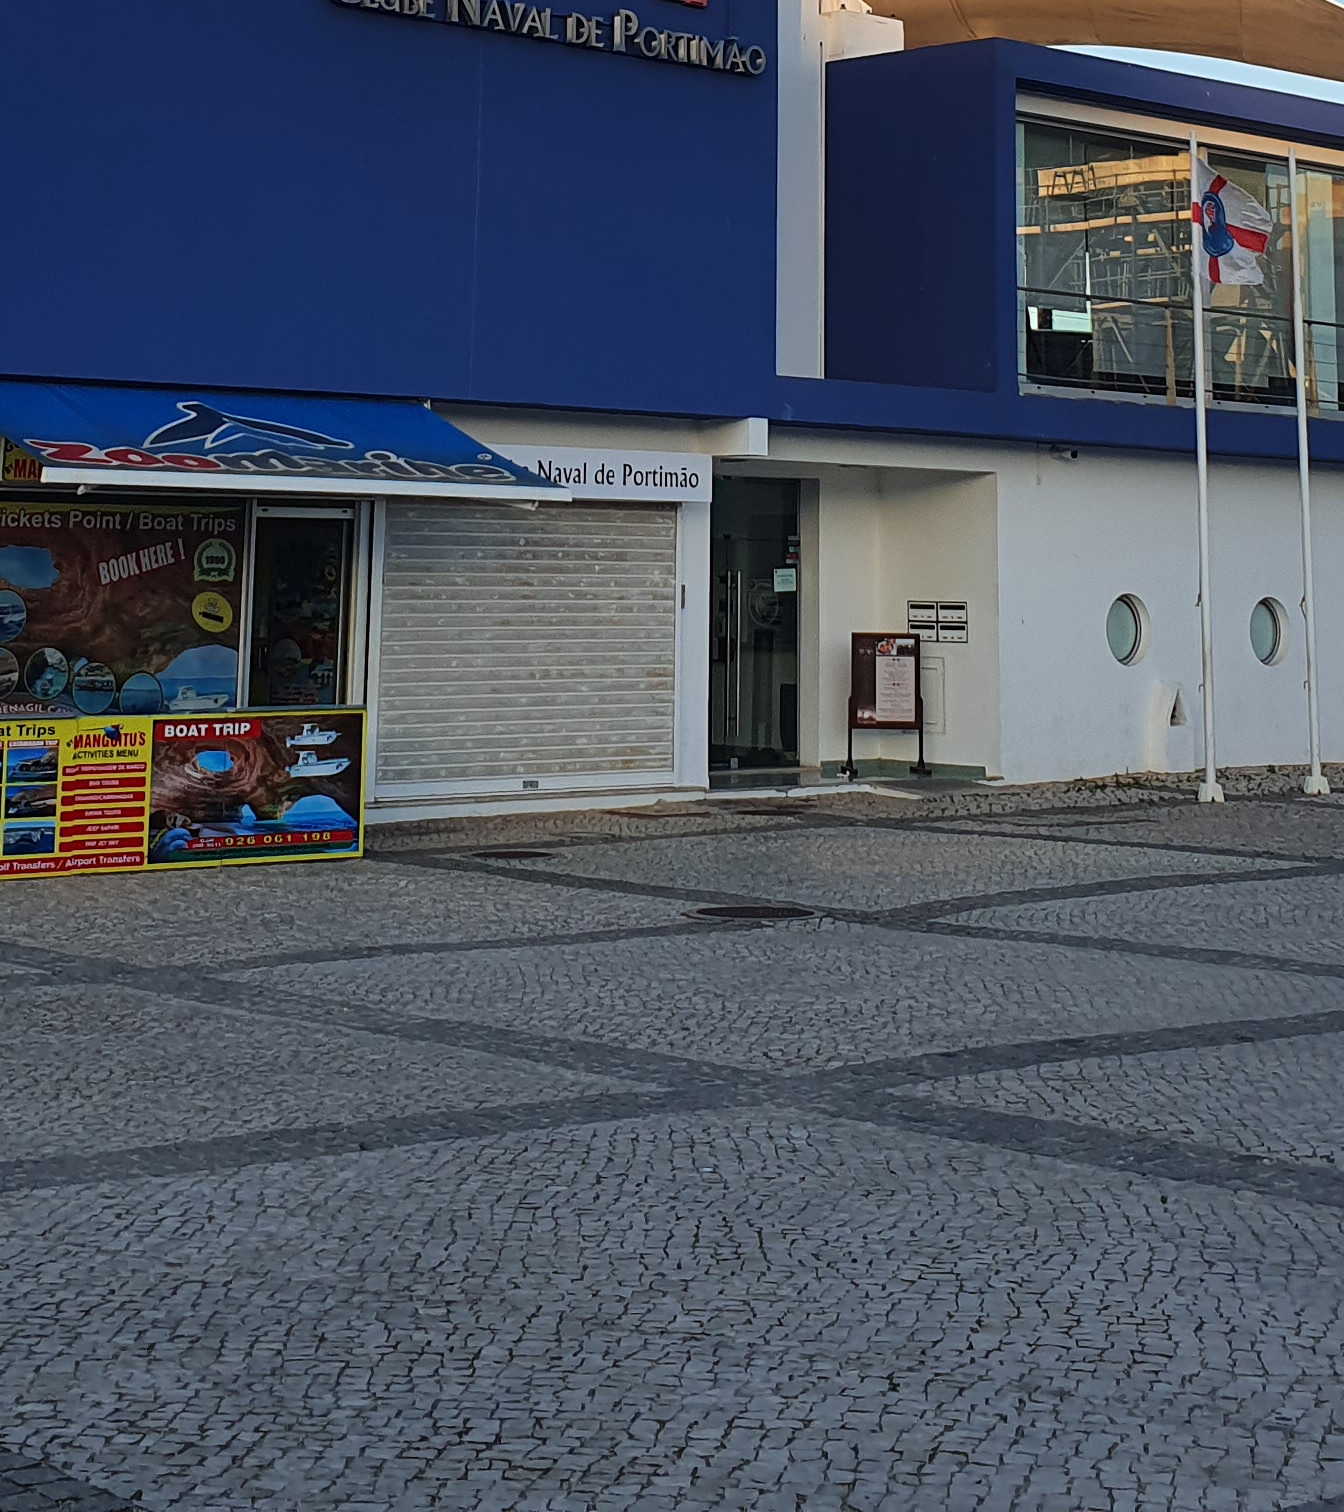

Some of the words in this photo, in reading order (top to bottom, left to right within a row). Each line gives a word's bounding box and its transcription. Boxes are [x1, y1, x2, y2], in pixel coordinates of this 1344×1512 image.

[566, 13, 606, 49] DE
[22, 437, 517, 482] zoomarine
[537, 459, 587, 485] Naval
[594, 463, 615, 486] de
[622, 463, 700, 489] Portimão
[68, 510, 121, 530] Point
[138, 512, 184, 531] Boat
[190, 513, 237, 535] Trips
[98, 552, 140, 586] BOOK
[140, 541, 176, 572] HERE
[15, 723, 56, 739] Trips
[164, 723, 208, 738] BOAT
[212, 722, 252, 737] TRIP
[72, 749, 114, 760] ACTIVITIES
[13, 859, 56, 871] Transfers
[65, 856, 97, 869] Airport
[99, 854, 142, 865] Transfers
